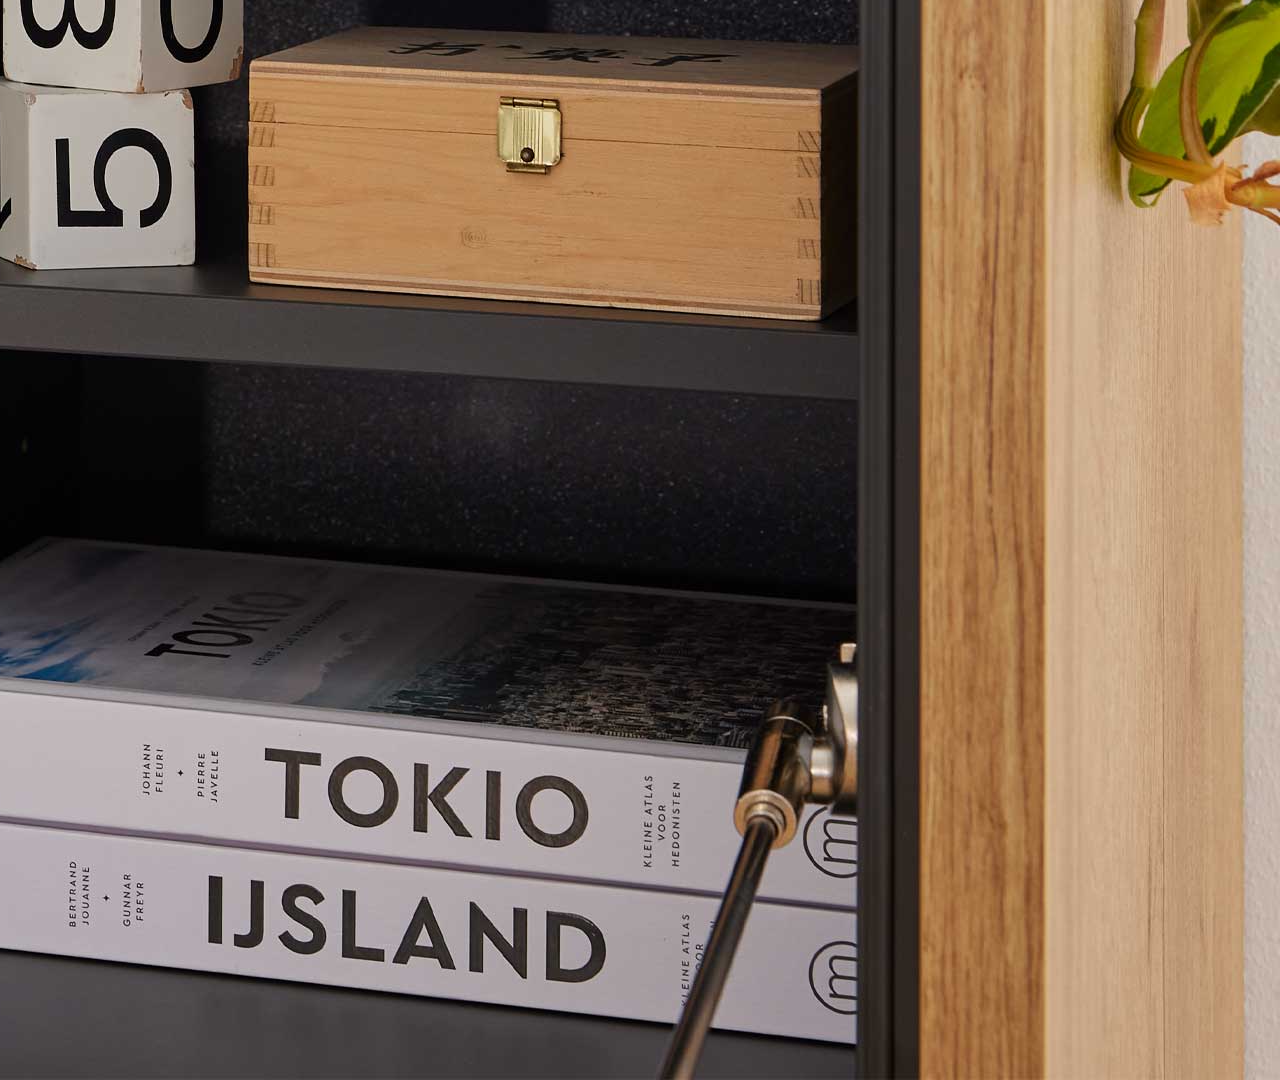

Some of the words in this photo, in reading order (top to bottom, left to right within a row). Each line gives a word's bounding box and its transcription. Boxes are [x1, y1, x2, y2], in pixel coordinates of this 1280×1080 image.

[55, 127, 173, 228] 5
[143, 591, 307, 659] TOKIO
[142, 744, 151, 796] JOHANN
[155, 748, 164, 793] FLEURI
[197, 752, 206, 797] PIERRE
[210, 750, 219, 803] JAVELLE
[644, 774, 653, 816] ATLAS
[264, 747, 589, 848] TOKIO
[658, 804, 666, 842] VOOR
[643, 820, 653, 868] KLEINE
[671, 781, 680, 868] HEDONISTEN
[68, 861, 77, 928] BERTRAND
[81, 866, 90, 926] JOUANNE
[122, 872, 132, 927] GUNNAR
[136, 882, 144, 922] FREYR
[208, 875, 607, 984] IJSLAND
[681, 914, 690, 955] ATLAS
